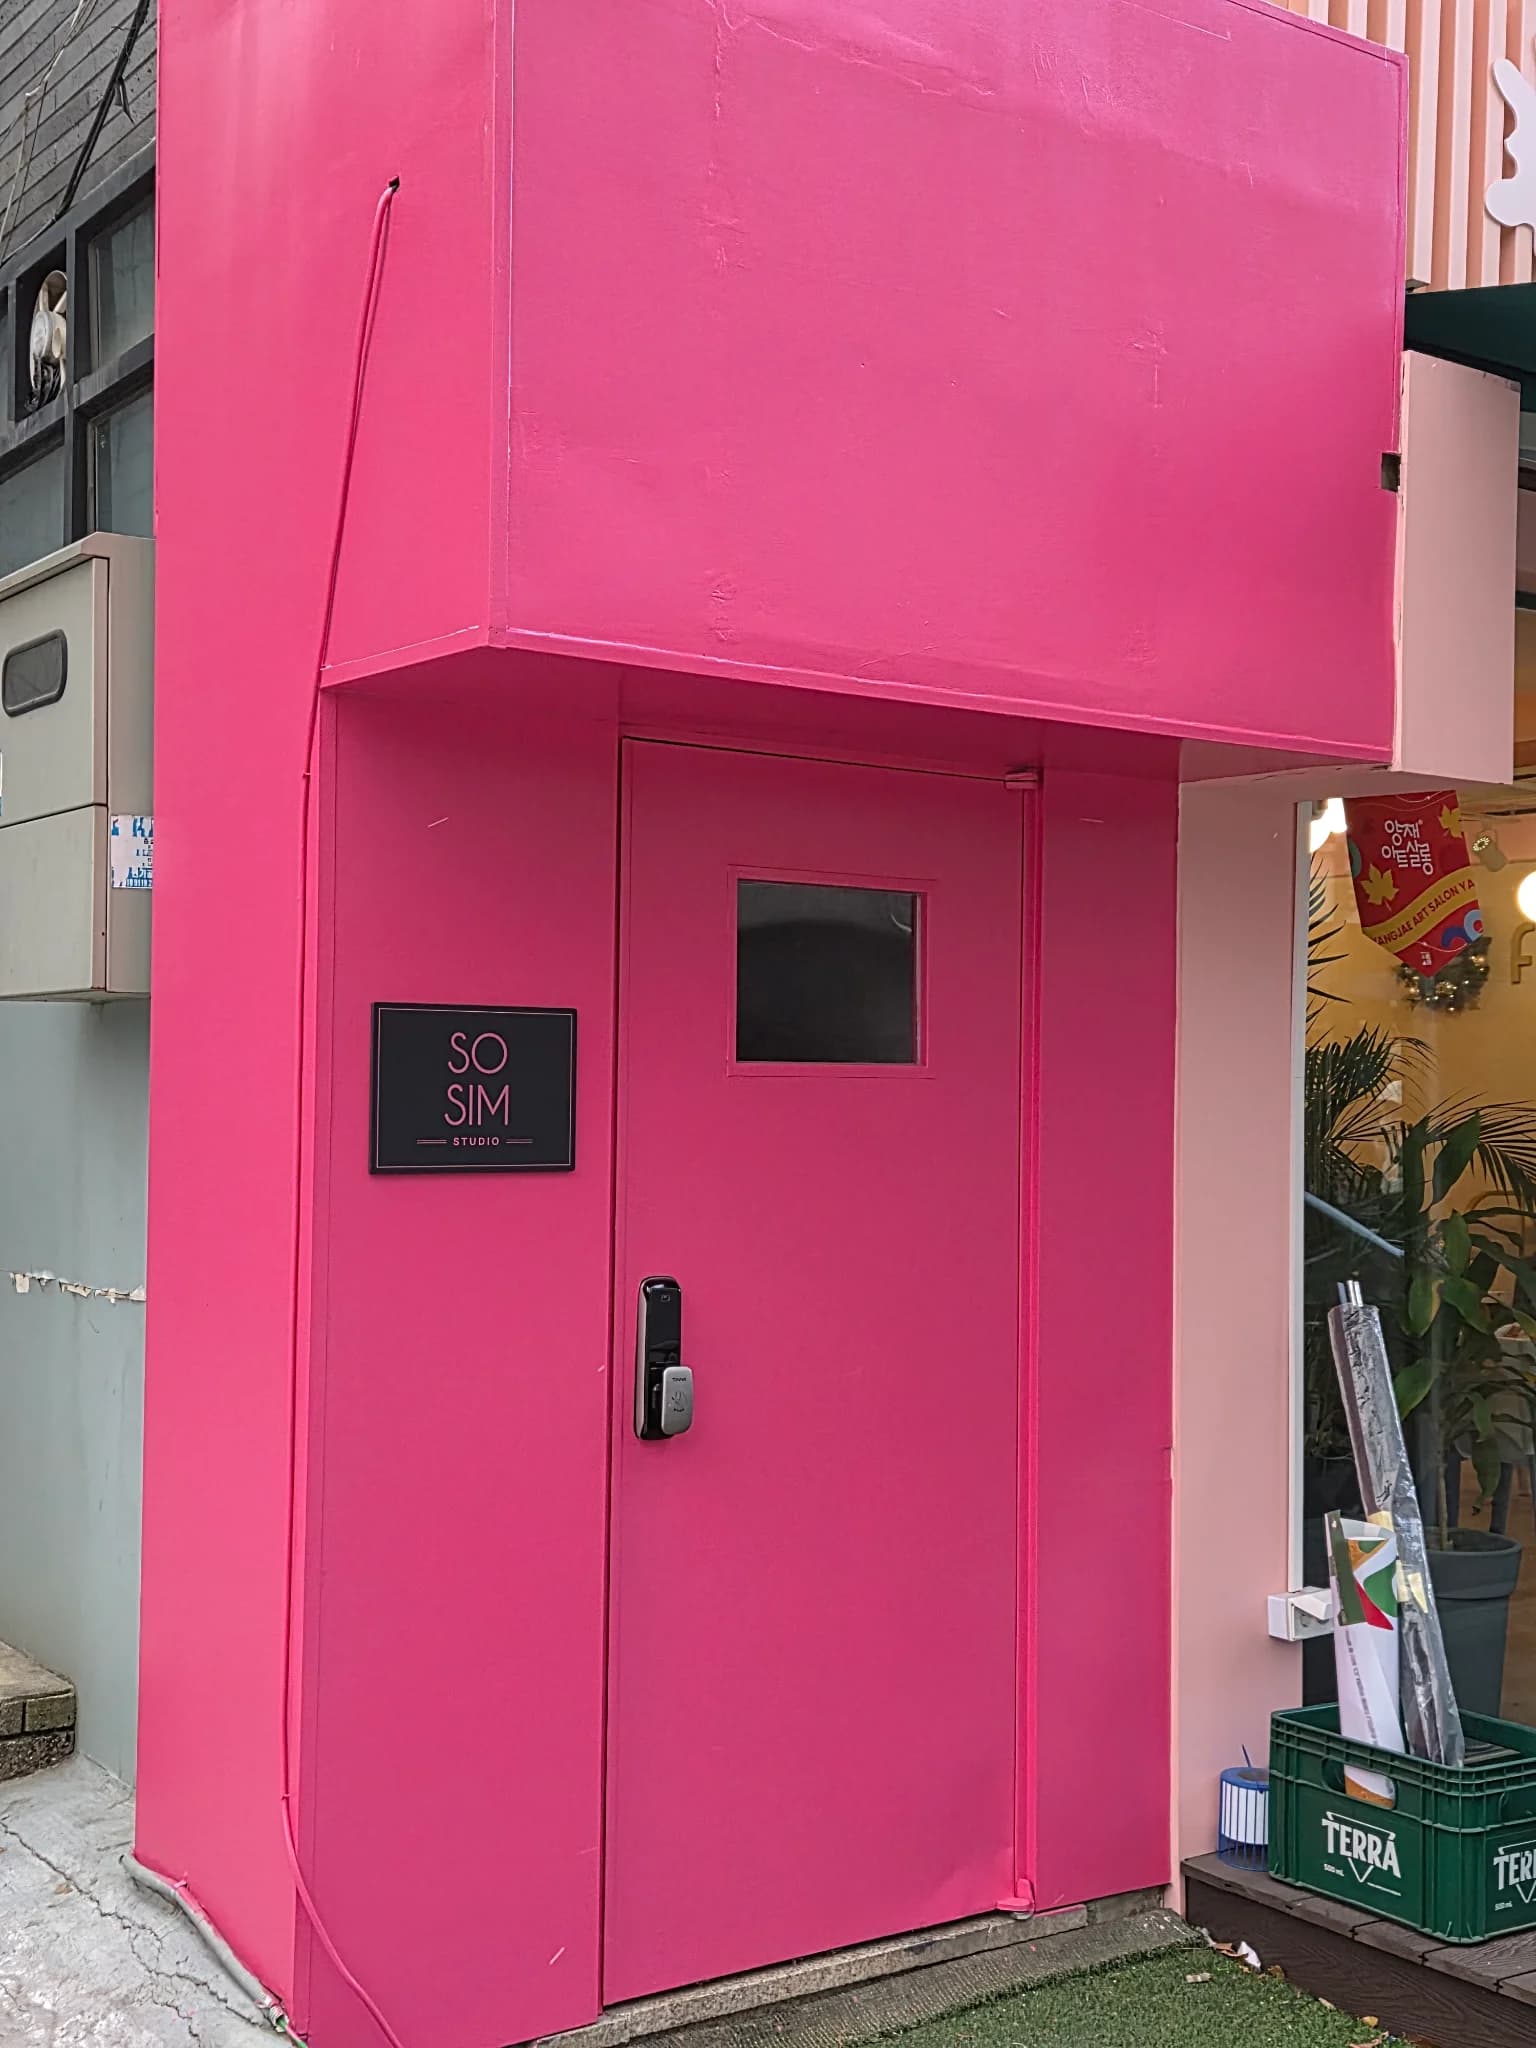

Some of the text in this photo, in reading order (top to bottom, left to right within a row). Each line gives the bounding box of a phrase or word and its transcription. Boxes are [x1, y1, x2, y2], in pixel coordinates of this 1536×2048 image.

[1384, 819, 1420, 846] 양재
[1412, 907, 1430, 926] ART
[1427, 886, 1460, 912] SALON
[447, 1032, 508, 1074] SO
[444, 1083, 510, 1126] SIM
[452, 1137, 500, 1146] STUDIO
[1321, 1817, 1402, 1879] TERRA
